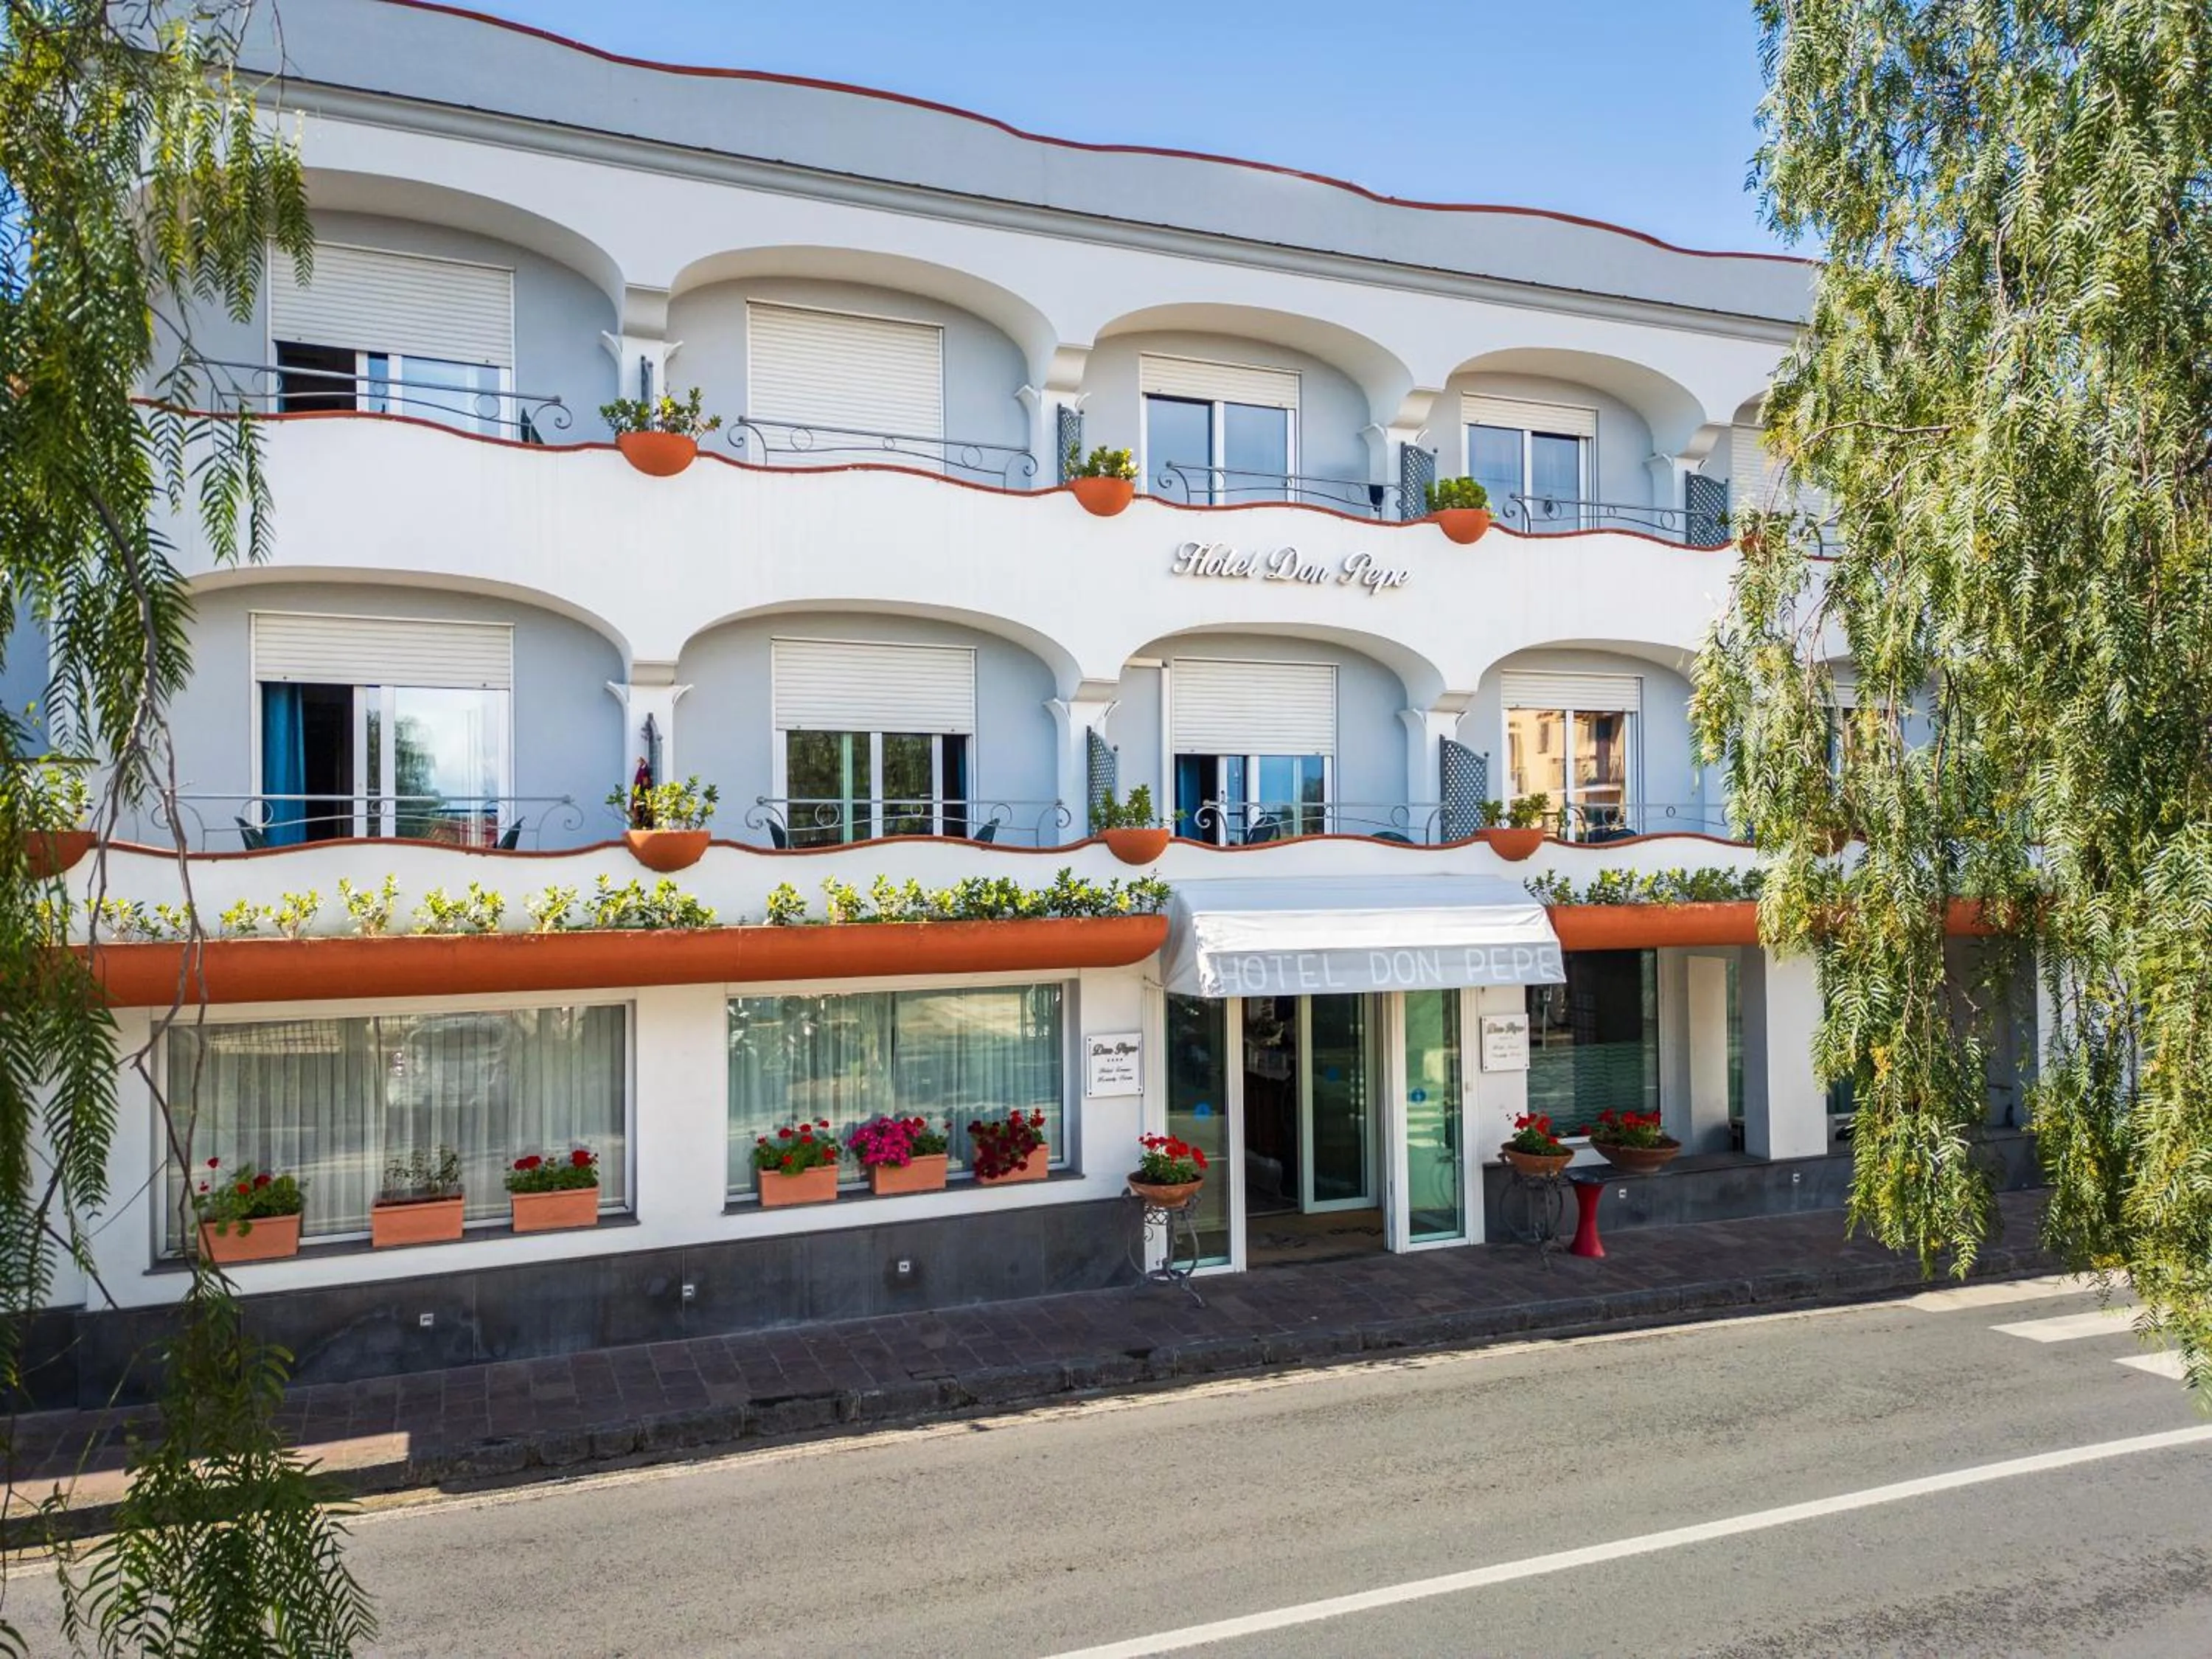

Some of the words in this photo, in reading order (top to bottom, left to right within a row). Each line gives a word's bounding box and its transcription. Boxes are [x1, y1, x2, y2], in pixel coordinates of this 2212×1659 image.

[1172, 540, 1259, 577] Hotel
[1264, 546, 1329, 584] Don
[1337, 552, 1411, 594] Pepe
[1217, 953, 1346, 992] HOTEL
[1369, 950, 1442, 984] DON
[1464, 947, 1561, 981] PEPE
